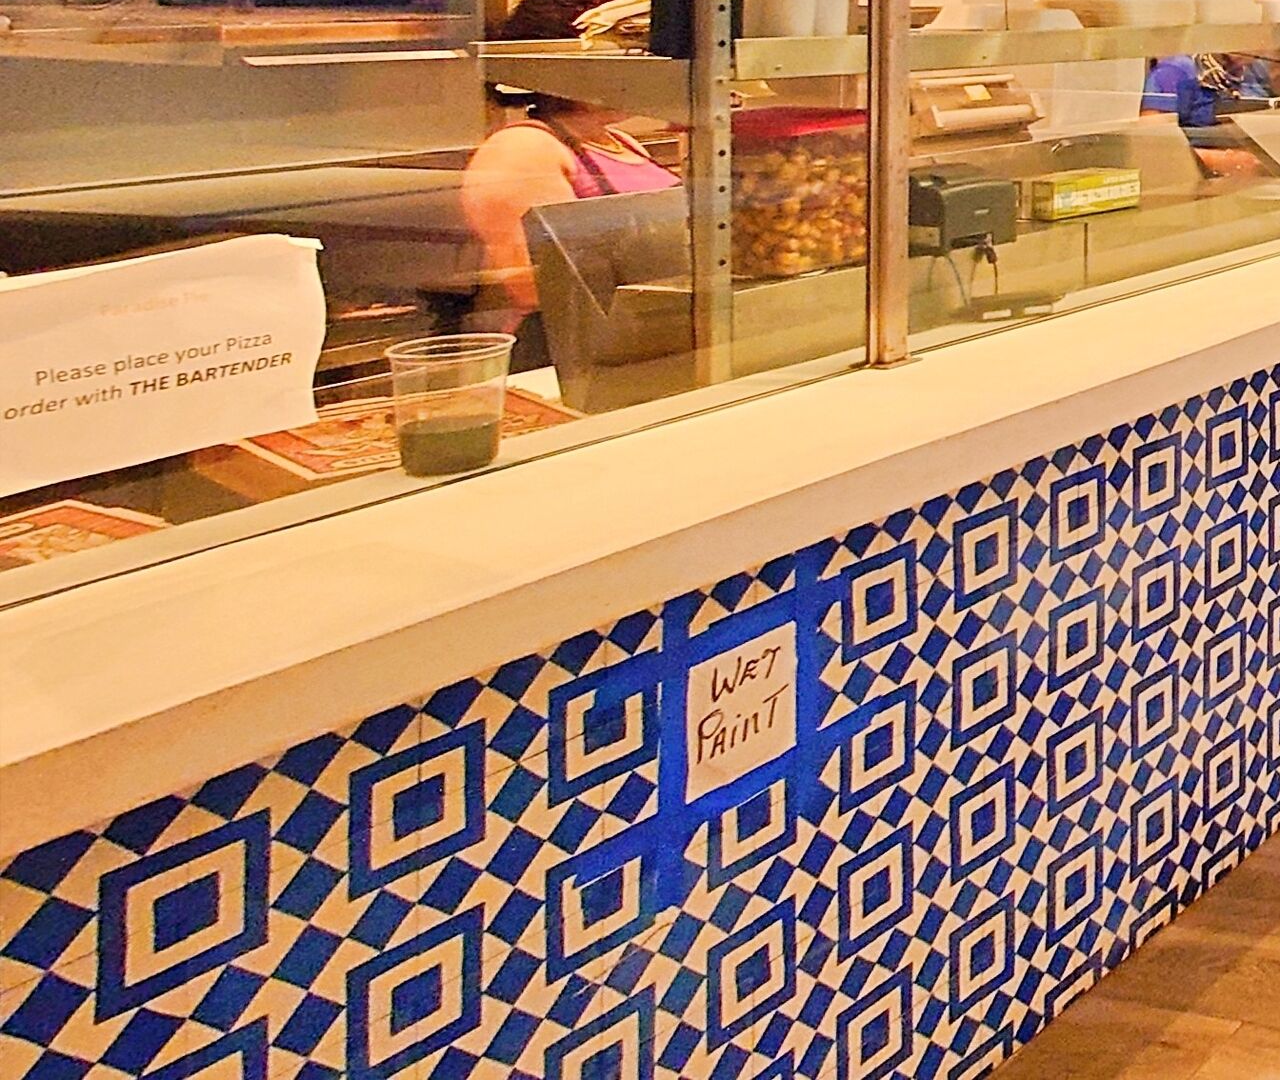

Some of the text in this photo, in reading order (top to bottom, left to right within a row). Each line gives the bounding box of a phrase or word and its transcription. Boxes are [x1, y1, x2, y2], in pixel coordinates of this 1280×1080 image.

[3, 352, 293, 421] order with THE BARTENDER
[35, 332, 273, 386] Please place your Pizza
[712, 646, 781, 702] WET
